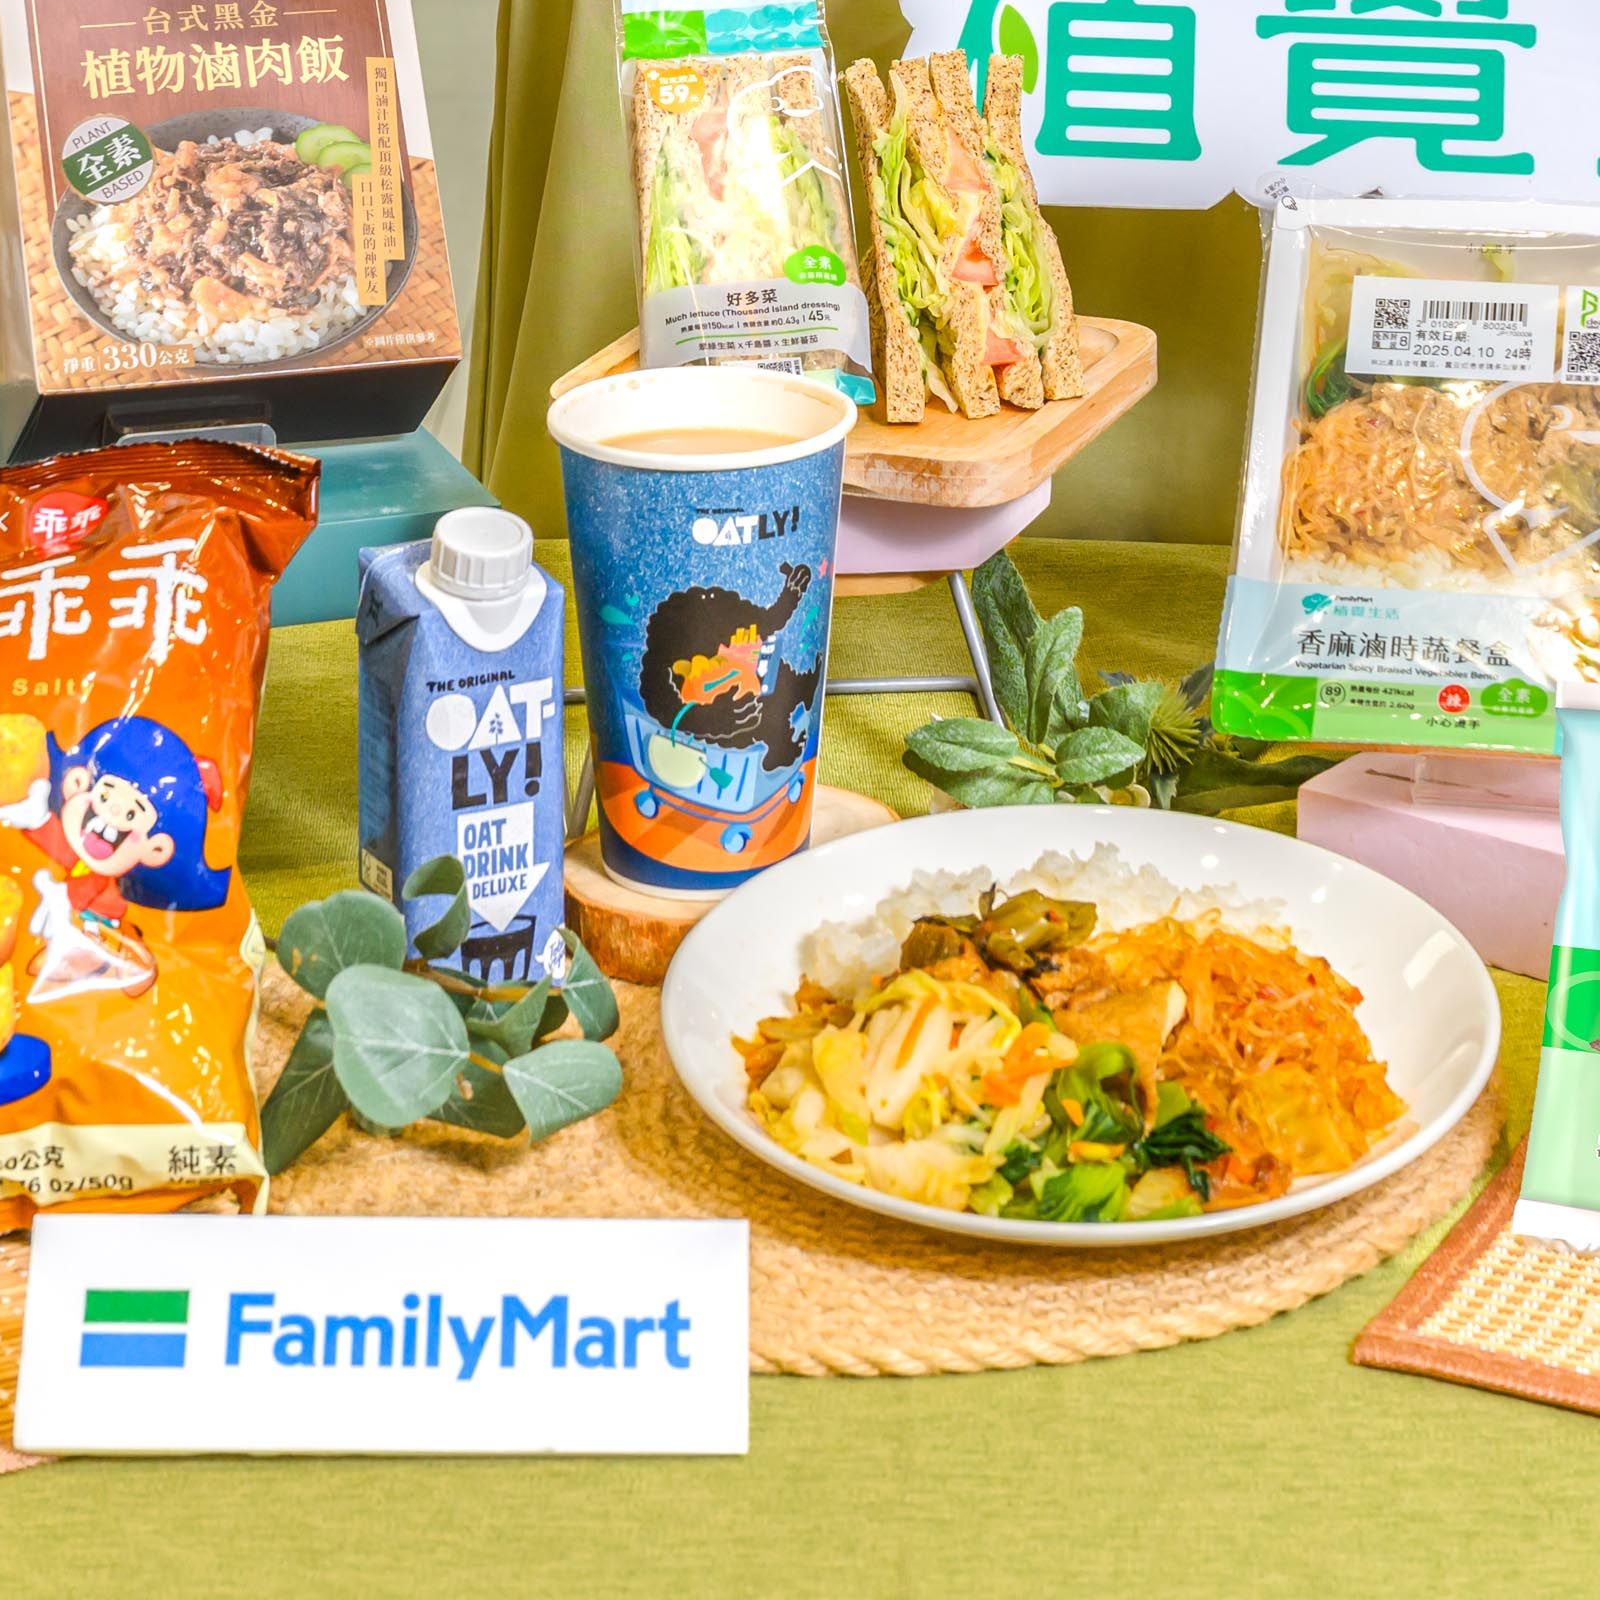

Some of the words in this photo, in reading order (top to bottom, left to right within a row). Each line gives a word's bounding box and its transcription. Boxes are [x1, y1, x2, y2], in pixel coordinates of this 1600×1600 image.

[141, 0, 281, 36] 台式黑金
[81, 34, 350, 99] 植物滷肉飯
[659, 83, 690, 106] 59
[71, 119, 113, 149] PLANT
[77, 133, 144, 187] 全素
[101, 168, 145, 201] BASED
[360, 180, 380, 295] 口口下飯的神隊友
[802, 255, 833, 270] 全素
[665, 311, 688, 327] Much
[689, 308, 721, 319] lettuce
[721, 305, 771, 318] (Thousand
[771, 302, 800, 314] Island
[800, 299, 841, 312] dressing)
[726, 288, 779, 308] 好多菜
[101, 341, 191, 372] 330公克
[1412, 344, 1496, 360] 2025.04.10
[32, 504, 103, 541] 乖乖
[691, 505, 800, 547] OATLY!
[425, 679, 455, 693] THE
[457, 668, 517, 690] ORIGINAL
[424, 675, 558, 752] OAT-
[450, 740, 543, 812] LY!
[462, 817, 508, 848] OAT
[462, 843, 531, 879] DRINK
[471, 873, 529, 901] DELUXE
[167, 1145, 238, 1176] 純素
[224, 1291, 692, 1381] FamilyMart
